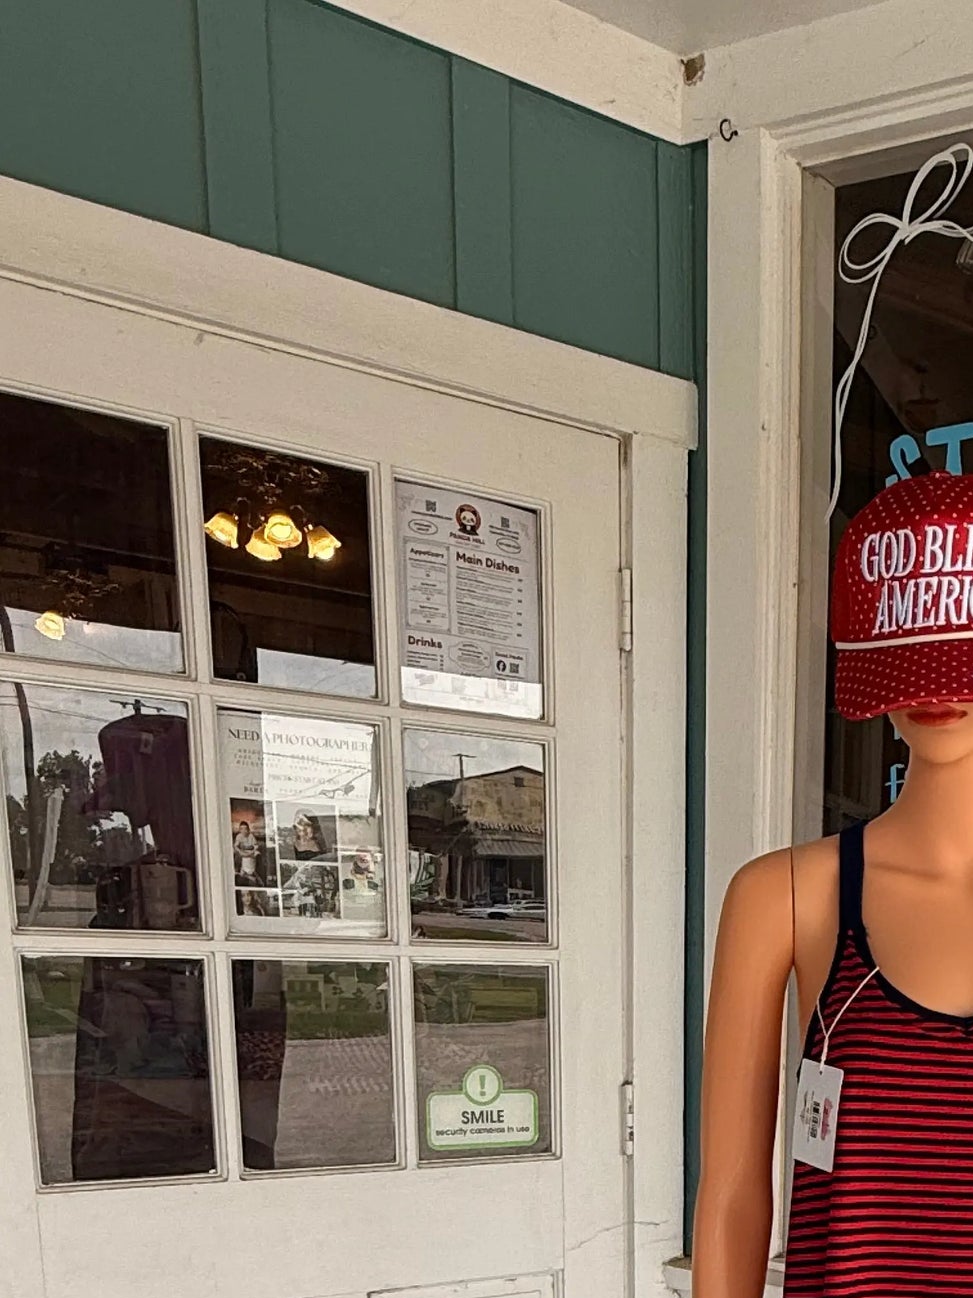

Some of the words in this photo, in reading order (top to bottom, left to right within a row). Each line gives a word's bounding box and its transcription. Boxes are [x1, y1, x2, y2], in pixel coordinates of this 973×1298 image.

[455, 551, 483, 567] Main
[484, 557, 520, 575] Dishes
[860, 528, 917, 583] GOD
[407, 634, 443, 649] Drinks
[228, 728, 260, 741] NEED
[272, 732, 369, 752] PHOTOGRAPHER
[461, 1109, 505, 1124] SMILE
[435, 1127, 468, 1137] security
[469, 1126, 505, 1135] cameras
